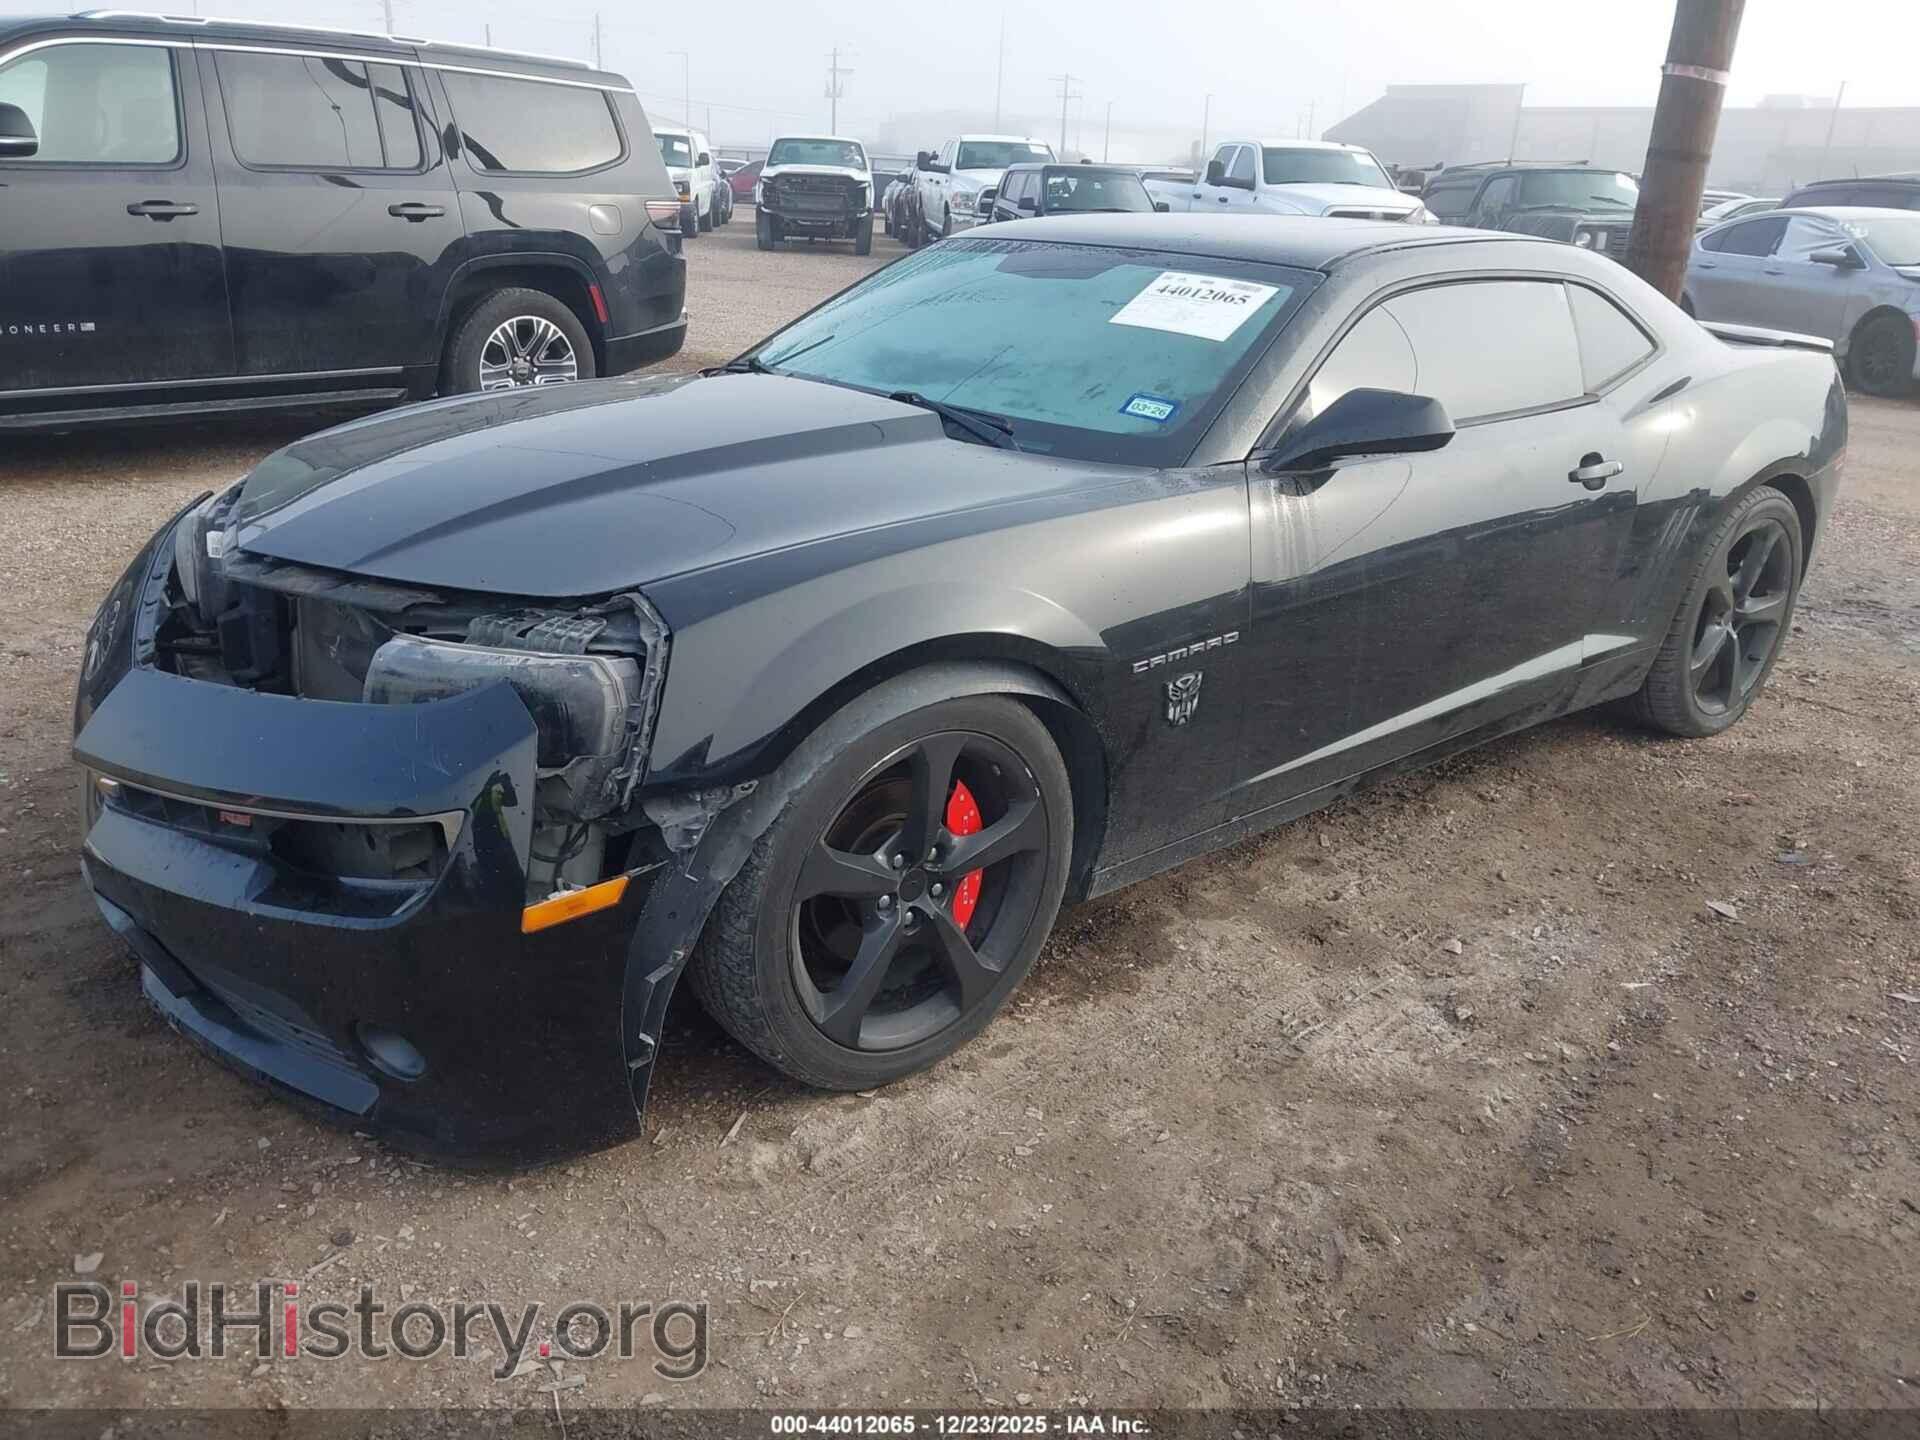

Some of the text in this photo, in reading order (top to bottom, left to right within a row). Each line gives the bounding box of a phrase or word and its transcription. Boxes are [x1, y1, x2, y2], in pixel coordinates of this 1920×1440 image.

[1156, 284, 1251, 305] 44012065
[0, 323, 76, 335] ONEER
[1132, 631, 1240, 674] CAMARO
